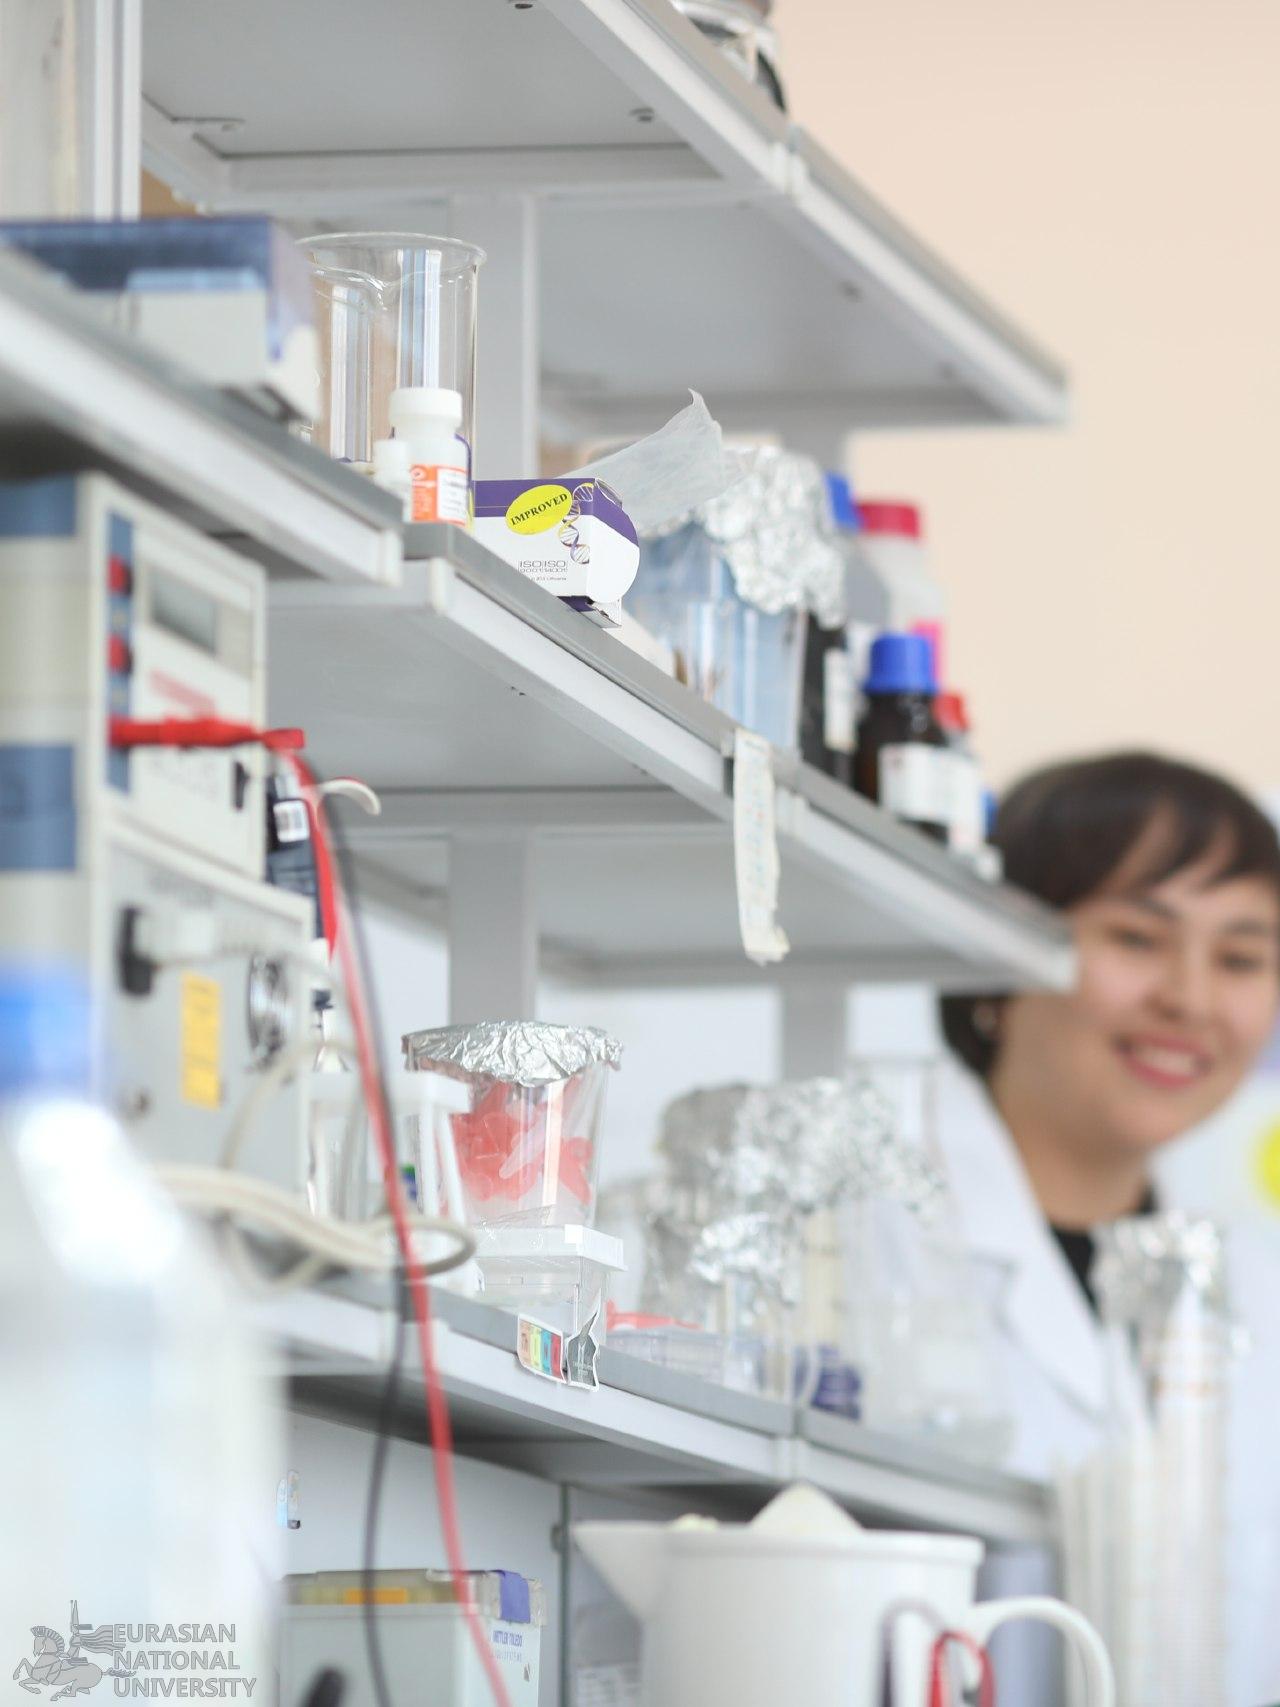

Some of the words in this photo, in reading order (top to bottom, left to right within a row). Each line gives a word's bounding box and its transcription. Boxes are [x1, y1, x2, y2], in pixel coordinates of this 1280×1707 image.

[511, 493, 568, 526] IMPROVED
[520, 560, 542, 568] ISO
[544, 560, 566, 568] ISO
